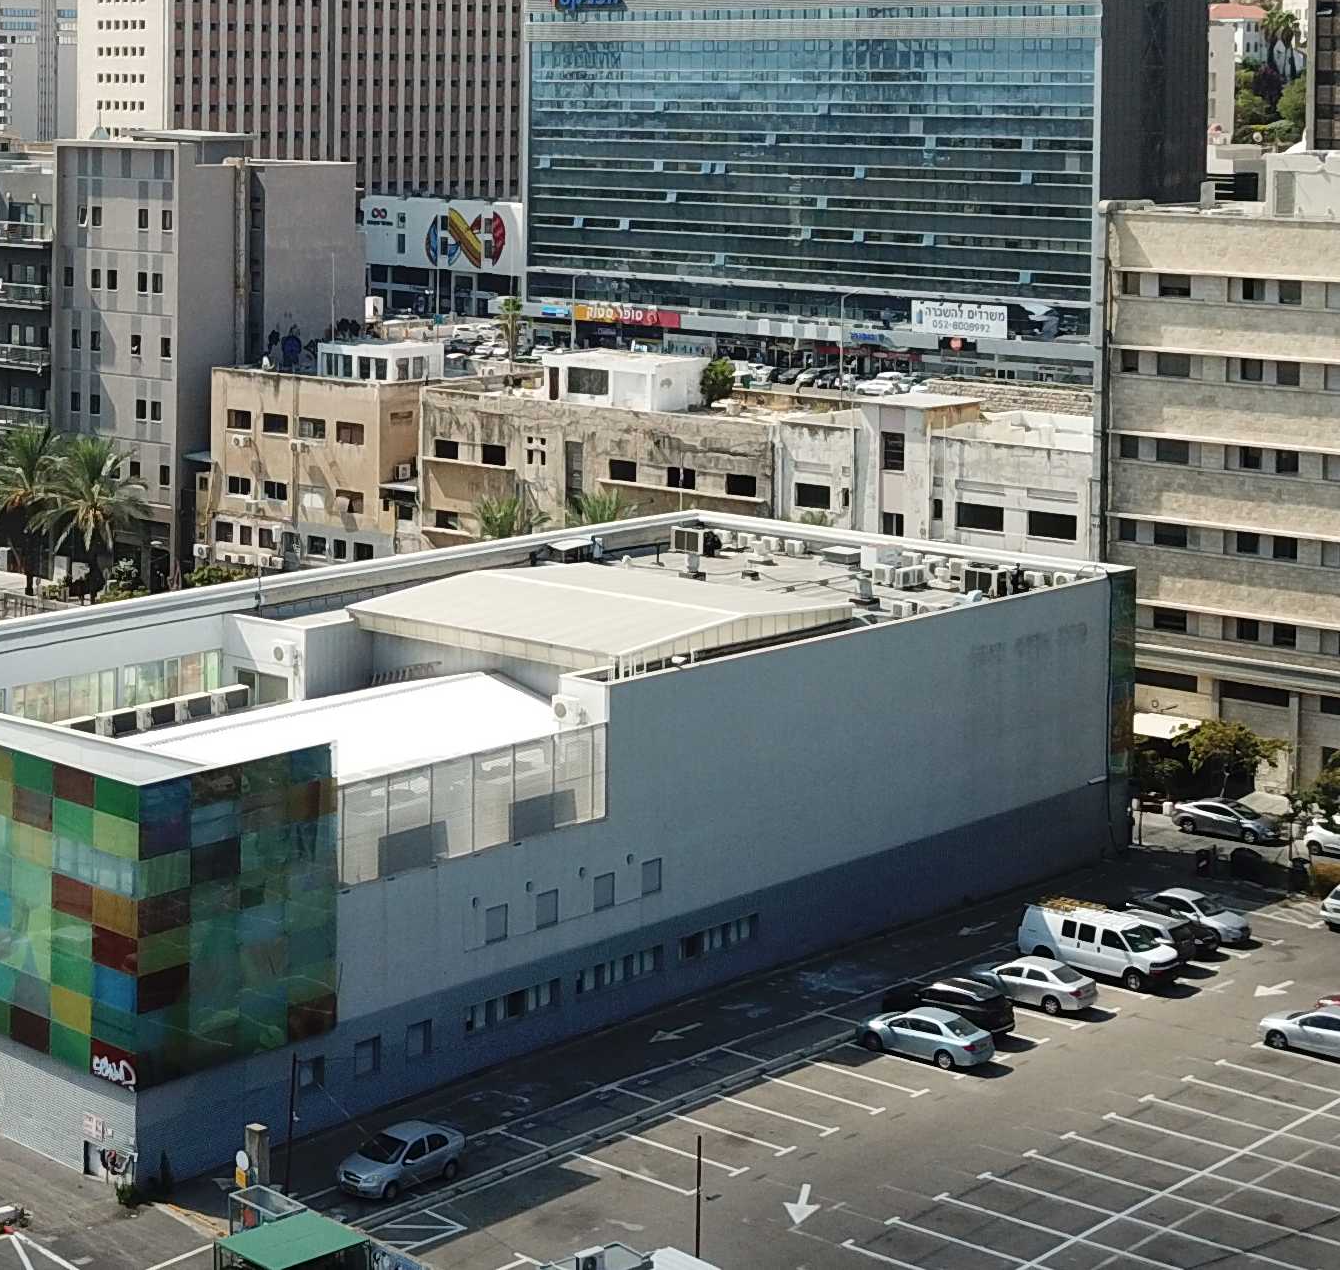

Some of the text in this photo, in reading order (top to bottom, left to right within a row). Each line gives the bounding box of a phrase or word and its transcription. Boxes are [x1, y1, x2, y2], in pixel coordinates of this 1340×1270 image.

[618, 305, 644, 321] סופר
[924, 306, 1005, 322] משרדים להשכרה
